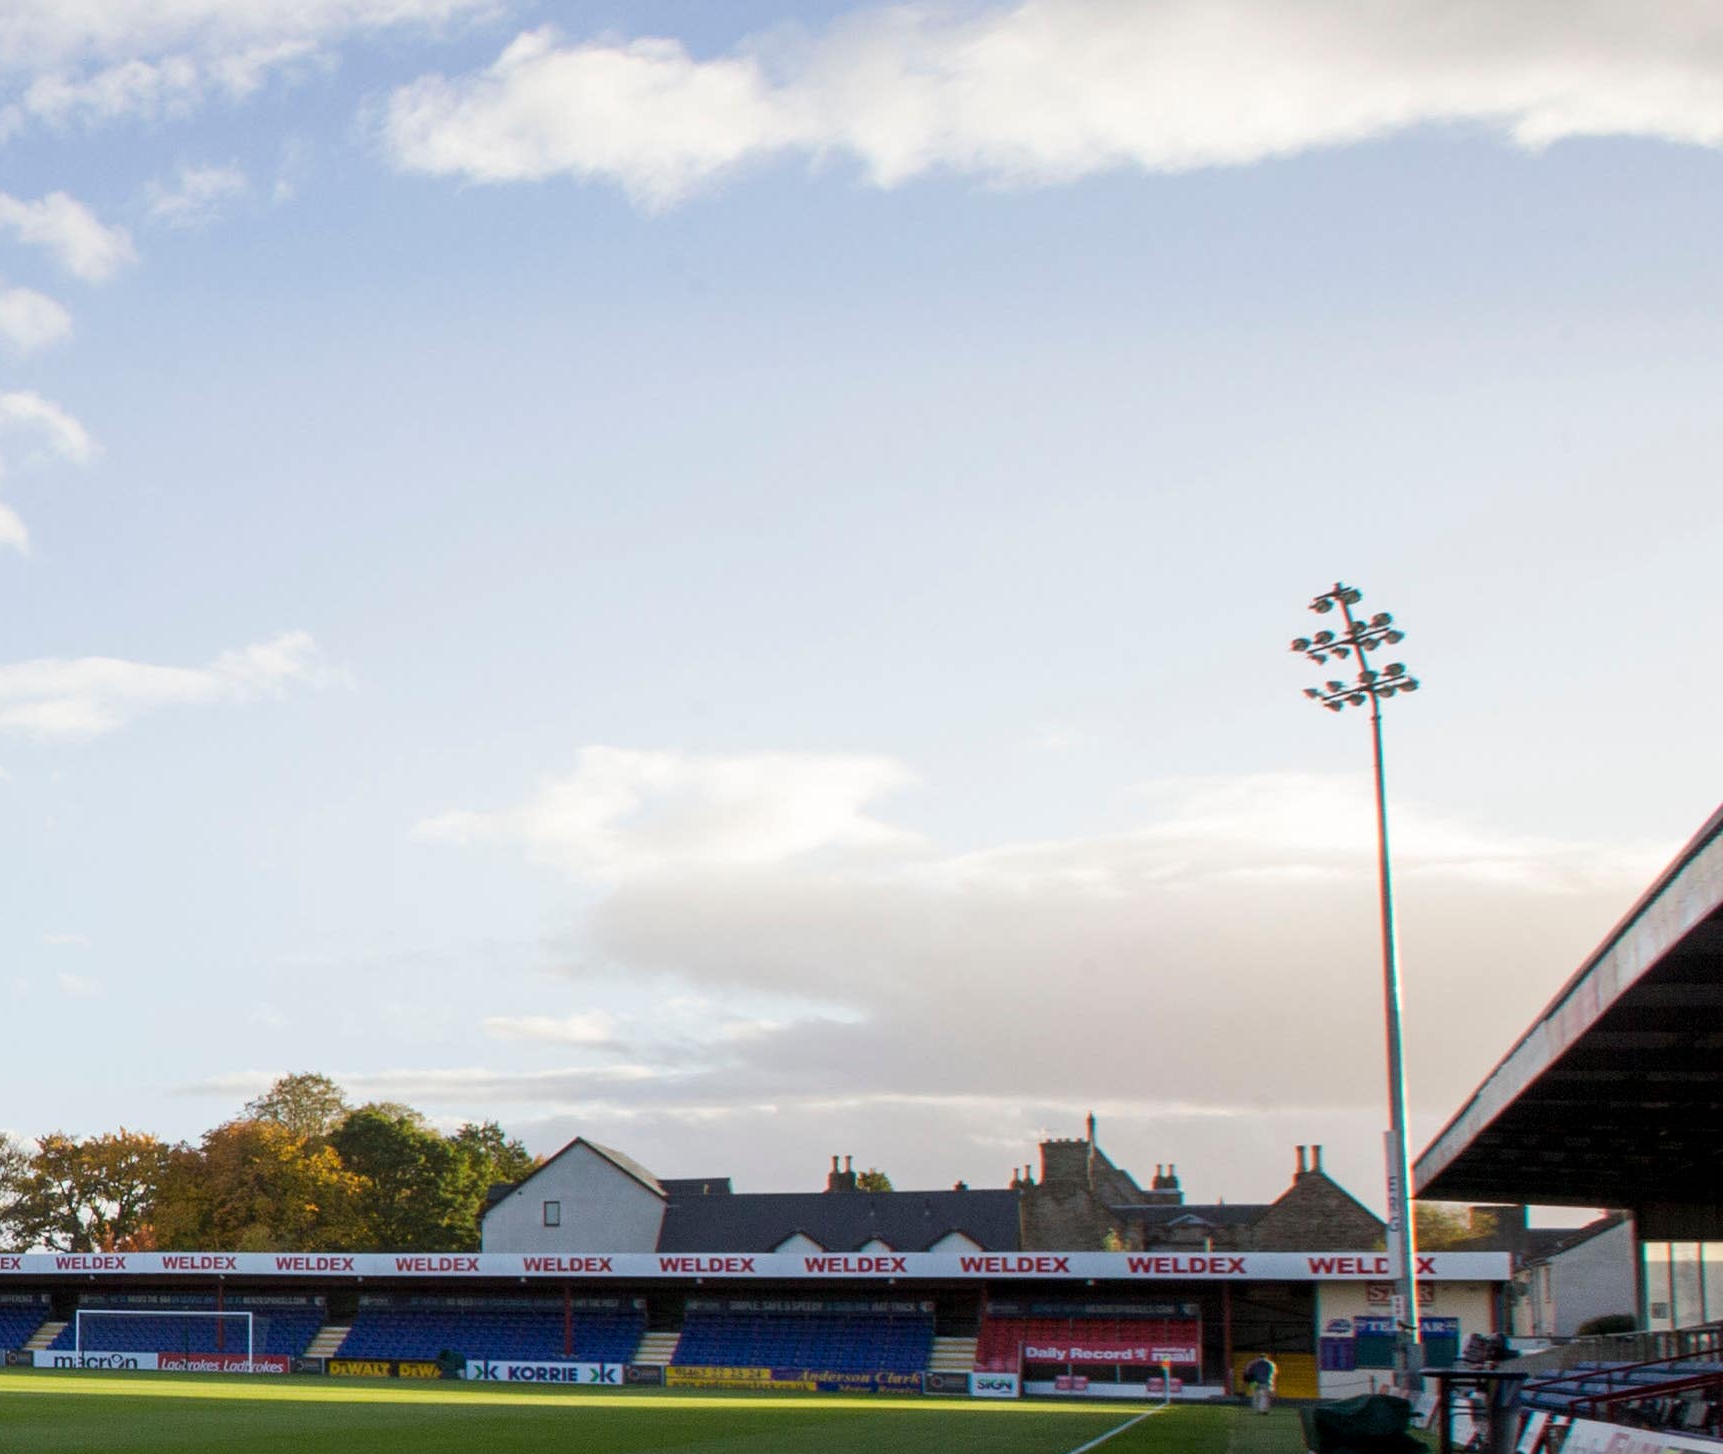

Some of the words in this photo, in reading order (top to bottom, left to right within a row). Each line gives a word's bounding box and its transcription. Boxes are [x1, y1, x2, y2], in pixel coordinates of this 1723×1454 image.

[56, 1257, 125, 1270] WELDEX
[163, 1257, 236, 1271] WELDEX
[276, 1257, 353, 1271] WELDEX
[395, 1257, 479, 1272] WELDEX
[523, 1257, 612, 1273] WELDEX
[659, 1257, 755, 1273] WELDEX
[804, 1256, 907, 1273] WELDEX
[960, 1256, 1069, 1273] WELDEX
[1127, 1256, 1246, 1274] WELDEX
[1309, 1257, 1436, 1274] WELDX
[1026, 1347, 1065, 1360] Daily
[1070, 1348, 1133, 1360] Record
[508, 1366, 579, 1382] KORRIE
[801, 1370, 870, 1383] Anderson
[874, 1371, 921, 1384] Clark
